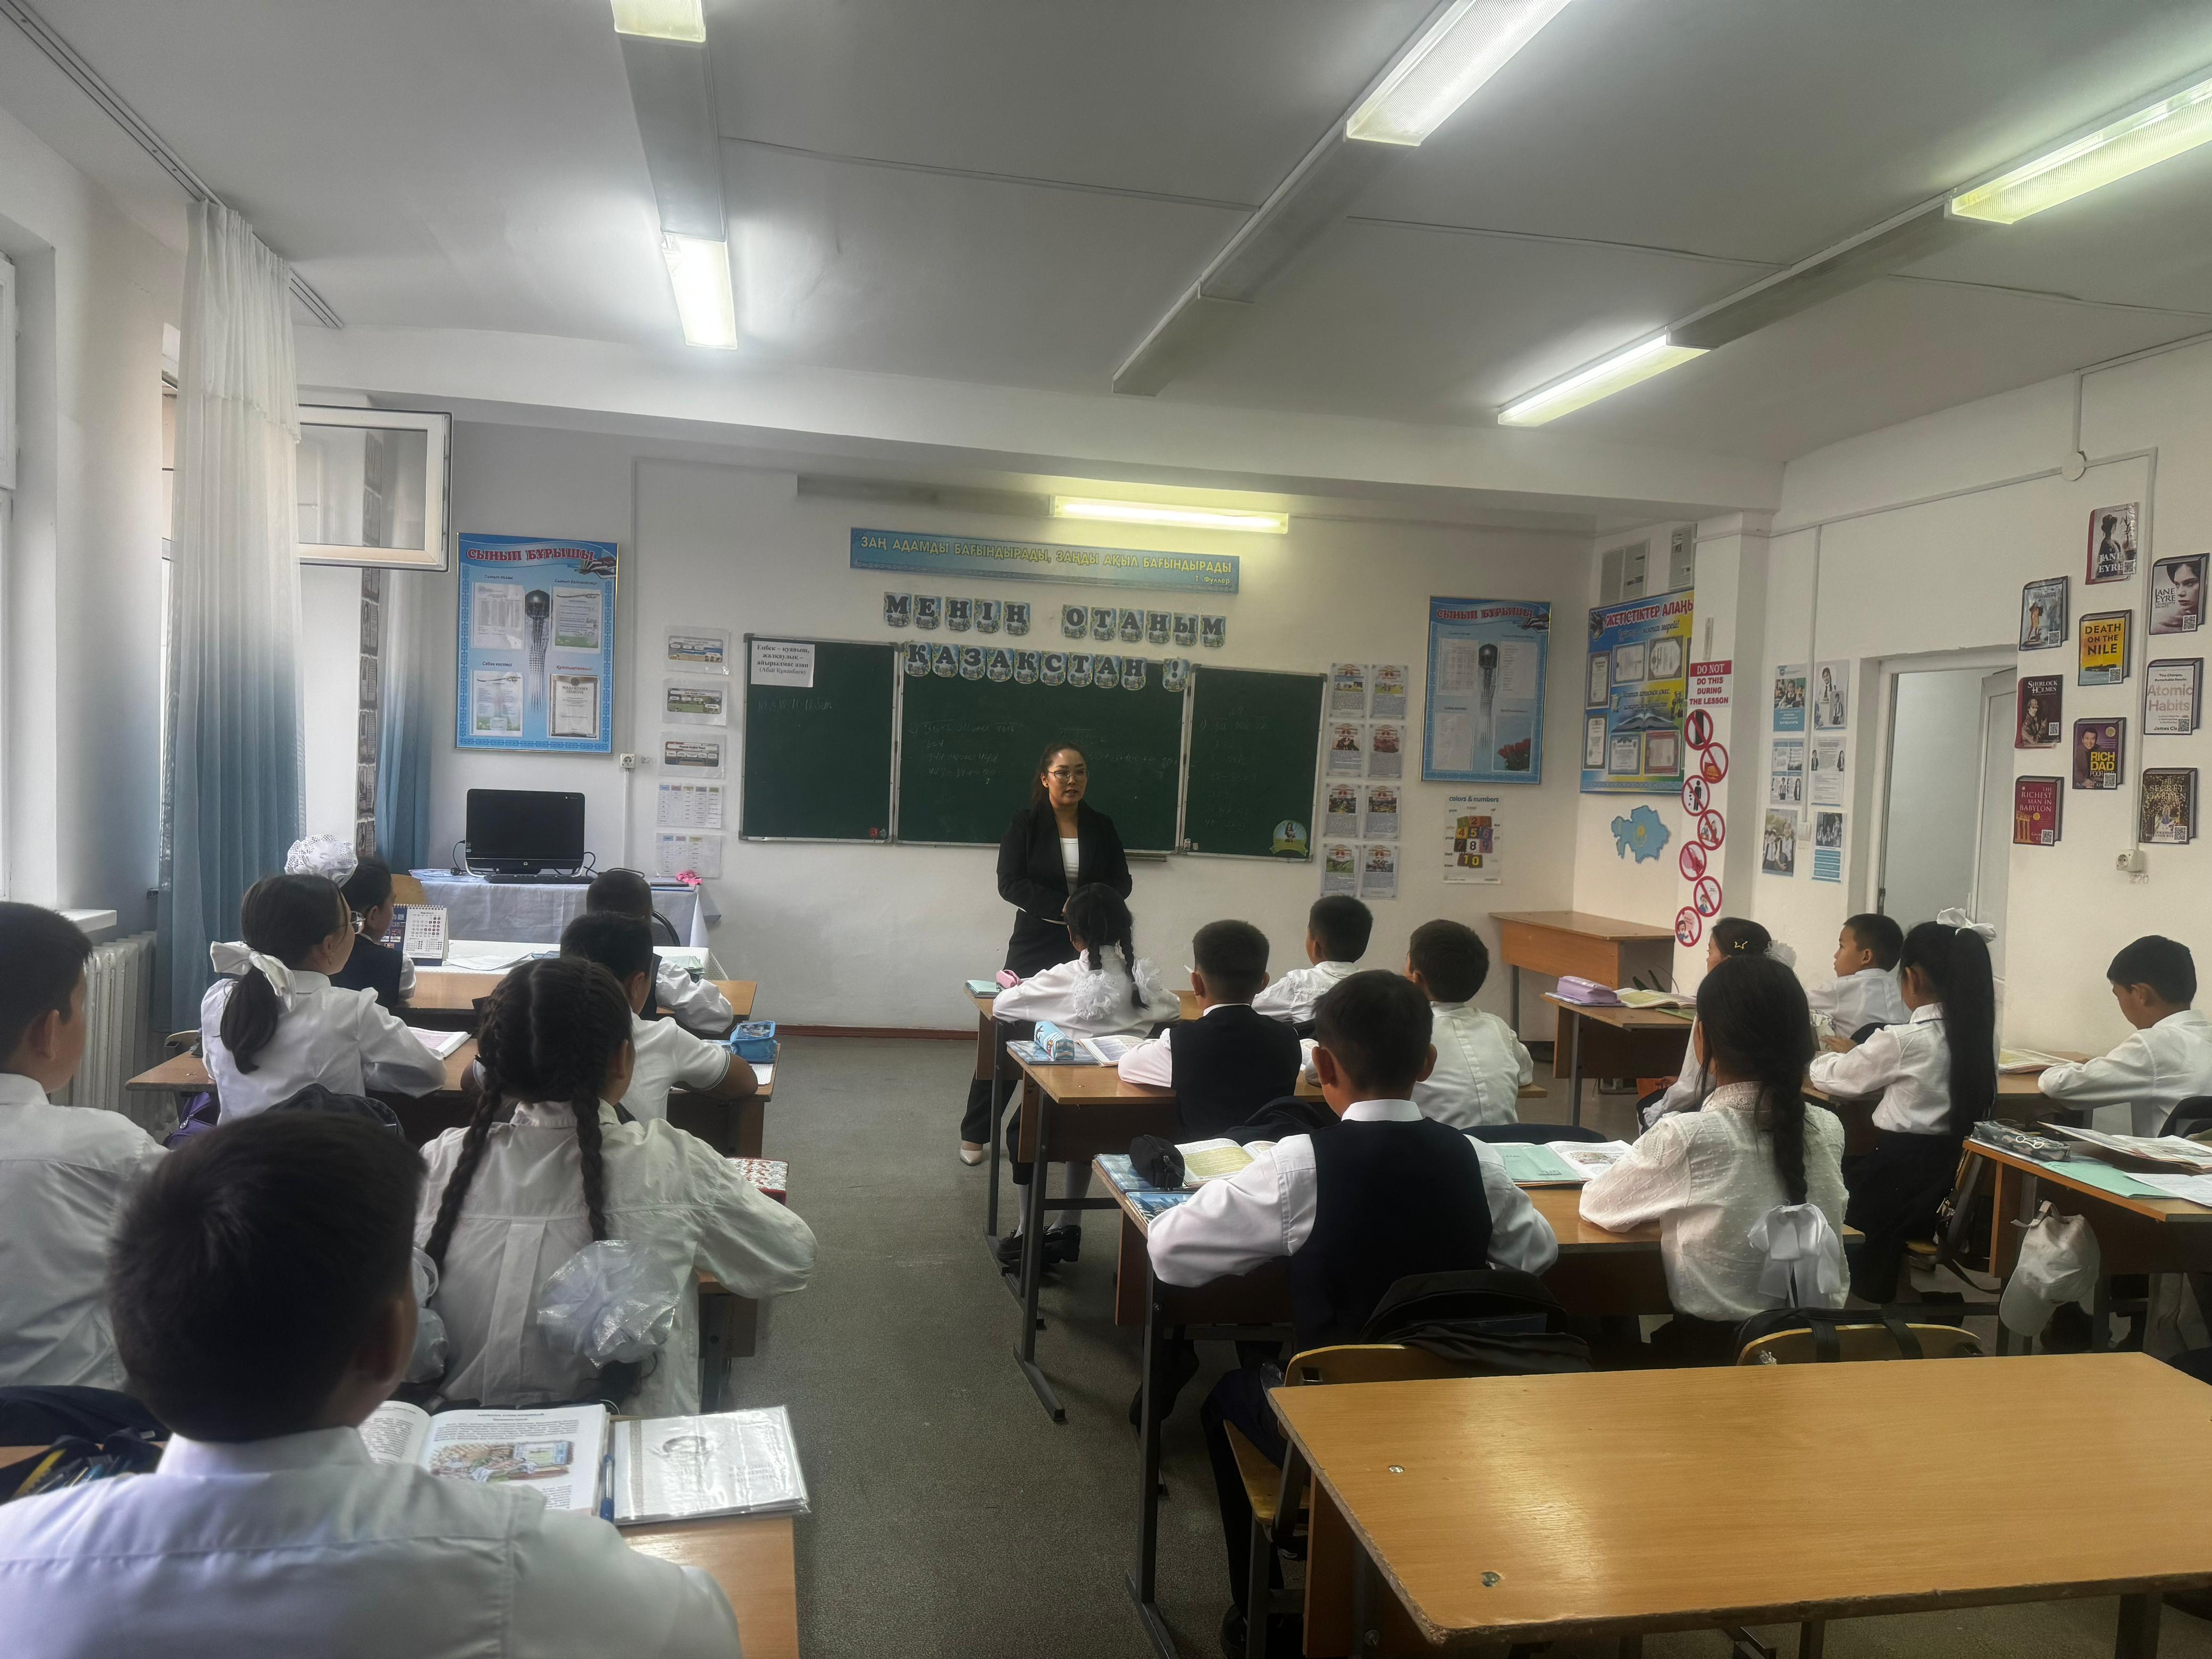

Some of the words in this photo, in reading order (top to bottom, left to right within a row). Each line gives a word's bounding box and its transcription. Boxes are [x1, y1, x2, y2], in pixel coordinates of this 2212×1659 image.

[467, 548, 523, 562] СЫНЫП
[526, 548, 595, 562] БҰРЫШЫ
[861, 535, 887, 551] ЗАҢ
[892, 539, 949, 554] АДАМДЫ
[954, 543, 1052, 563] БАҒЫНДЫРАДЫ,
[1056, 550, 1099, 566] ЗАҢДЫ
[1103, 554, 1139, 568] АҚЫЛ
[1143, 556, 1232, 574] БАҒЫНДЫРАДЫ
[2099, 552, 2122, 563] JANE
[2099, 563, 2123, 573] EYRE
[1204, 576, 1230, 585] Фуллер
[2155, 588, 2175, 597] JANE
[885, 594, 1027, 624] МЕНІҢ
[1066, 607, 1223, 637] ОТАНЫМ
[1437, 608, 1478, 620] СЫНЫП
[1480, 607, 1533, 619] БҰРЫШЫ
[1606, 605, 1660, 627] ЖЕТІСТІКТЕР
[2085, 623, 2121, 634] DEATH
[2088, 643, 2117, 656] NILE
[1697, 665, 1707, 674] DO
[1709, 664, 1724, 674] NOT
[2027, 680, 2057, 689] SHERLOCK
[2148, 684, 2193, 696] Atomic
[2148, 699, 2190, 711] Habits
[2090, 751, 2115, 762] RICH
[2090, 761, 2115, 771] DAD
[2020, 804, 2051, 812] BABYLON
[1459, 828, 1465, 837] 4
[1470, 828, 1477, 837] 5
[1482, 829, 1489, 838] 6
[1470, 841, 1477, 850] 8
[1482, 841, 1489, 850] 9
